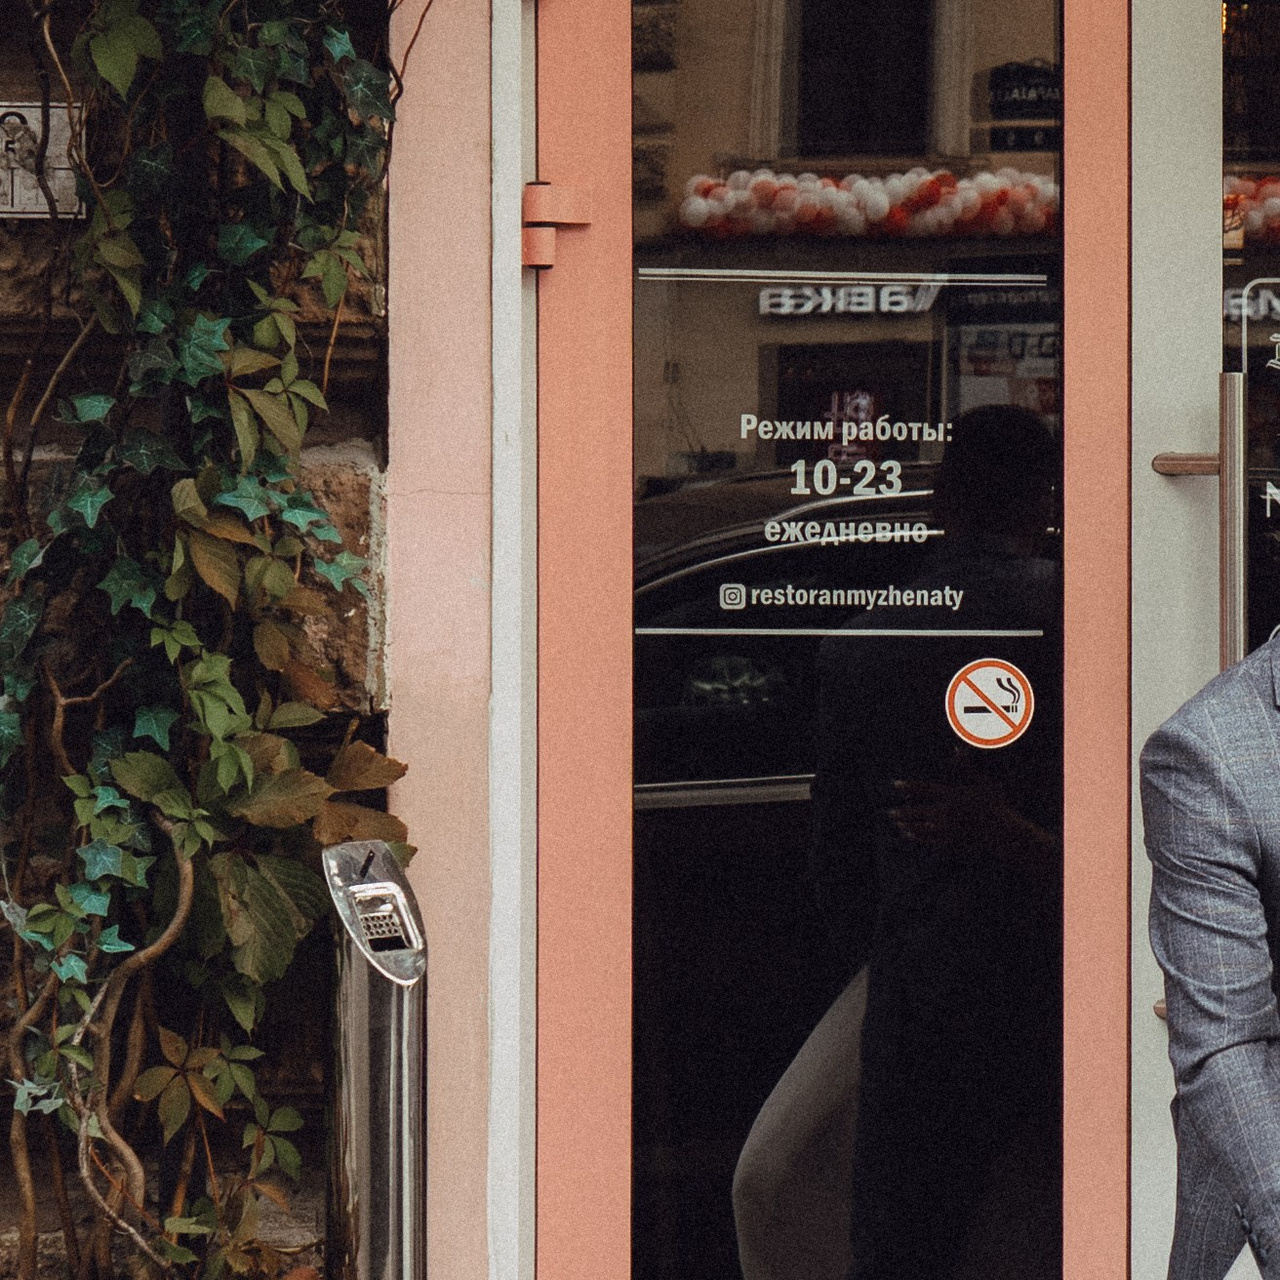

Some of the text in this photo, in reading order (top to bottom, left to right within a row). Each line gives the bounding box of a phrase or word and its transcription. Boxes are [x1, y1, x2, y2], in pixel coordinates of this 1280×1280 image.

[740, 414, 834, 442] Режим
[841, 414, 954, 446] работы:
[789, 459, 903, 496] 10-23
[763, 518, 929, 546] ежедневно
[750, 583, 965, 610] restoranmyzhenaty
